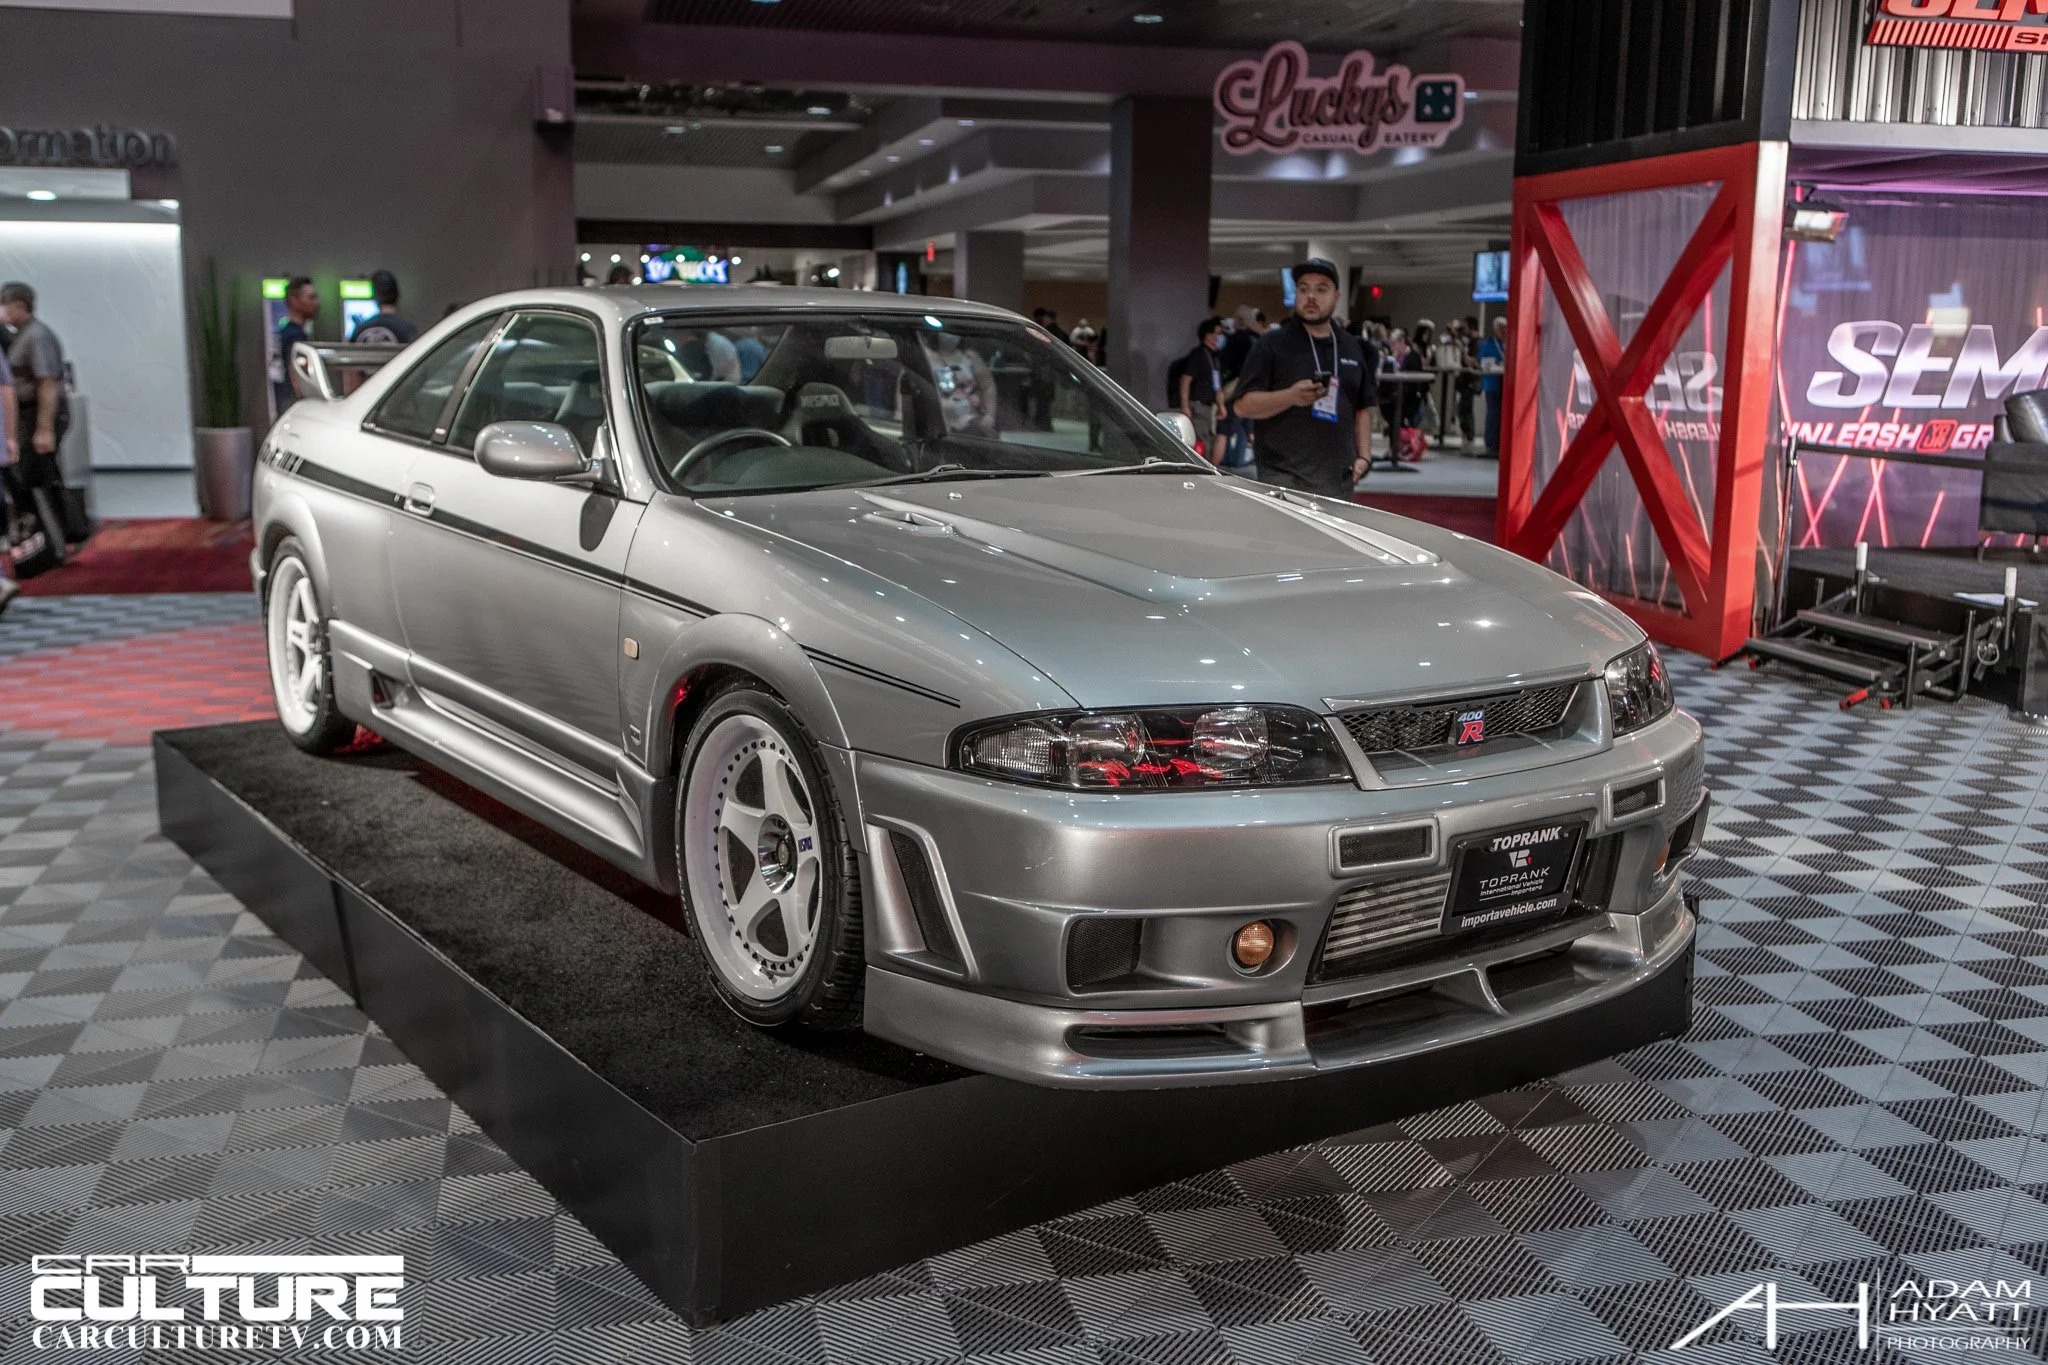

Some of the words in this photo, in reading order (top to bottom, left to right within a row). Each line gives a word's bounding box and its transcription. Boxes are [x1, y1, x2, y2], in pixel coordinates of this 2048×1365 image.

[2015, 32, 2048, 45] S
[1302, 132, 1354, 144] CASUAL
[1384, 131, 1438, 144] EATERY
[1806, 320, 2048, 408] SEM
[1458, 711, 1484, 722] 400
[1458, 720, 1484, 744] R
[1491, 826, 1562, 851] TOPRANK
[1480, 866, 1550, 889] TOPRANK
[1480, 883, 1522, 896] International
[1522, 879, 1544, 888] Vehicle
[1461, 898, 1557, 928] importavehicle.com
